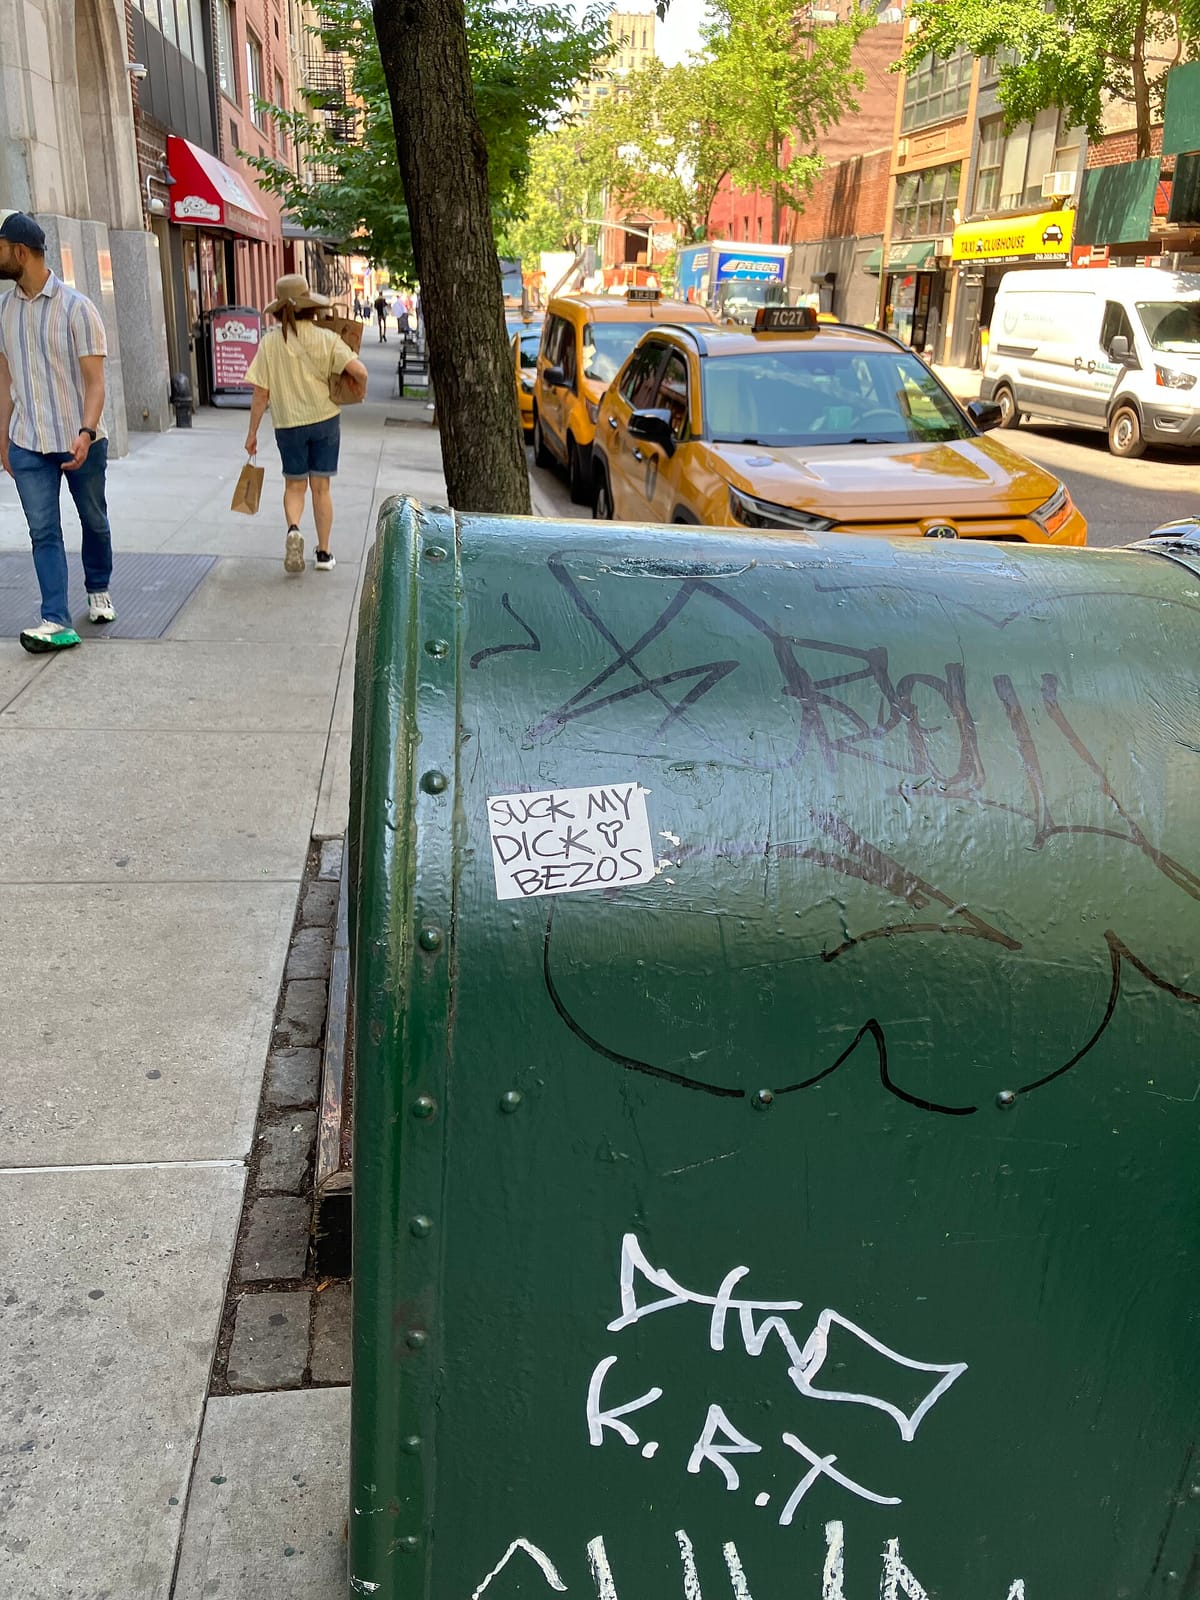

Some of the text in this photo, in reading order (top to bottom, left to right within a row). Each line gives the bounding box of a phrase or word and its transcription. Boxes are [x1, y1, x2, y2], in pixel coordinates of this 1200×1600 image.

[961, 235, 1025, 254] TAXI CLUBHOUSE
[773, 311, 803, 326] 7C27
[491, 788, 632, 827] SUCK MY
[492, 825, 596, 865] DICK
[510, 848, 642, 896] BEZOS
